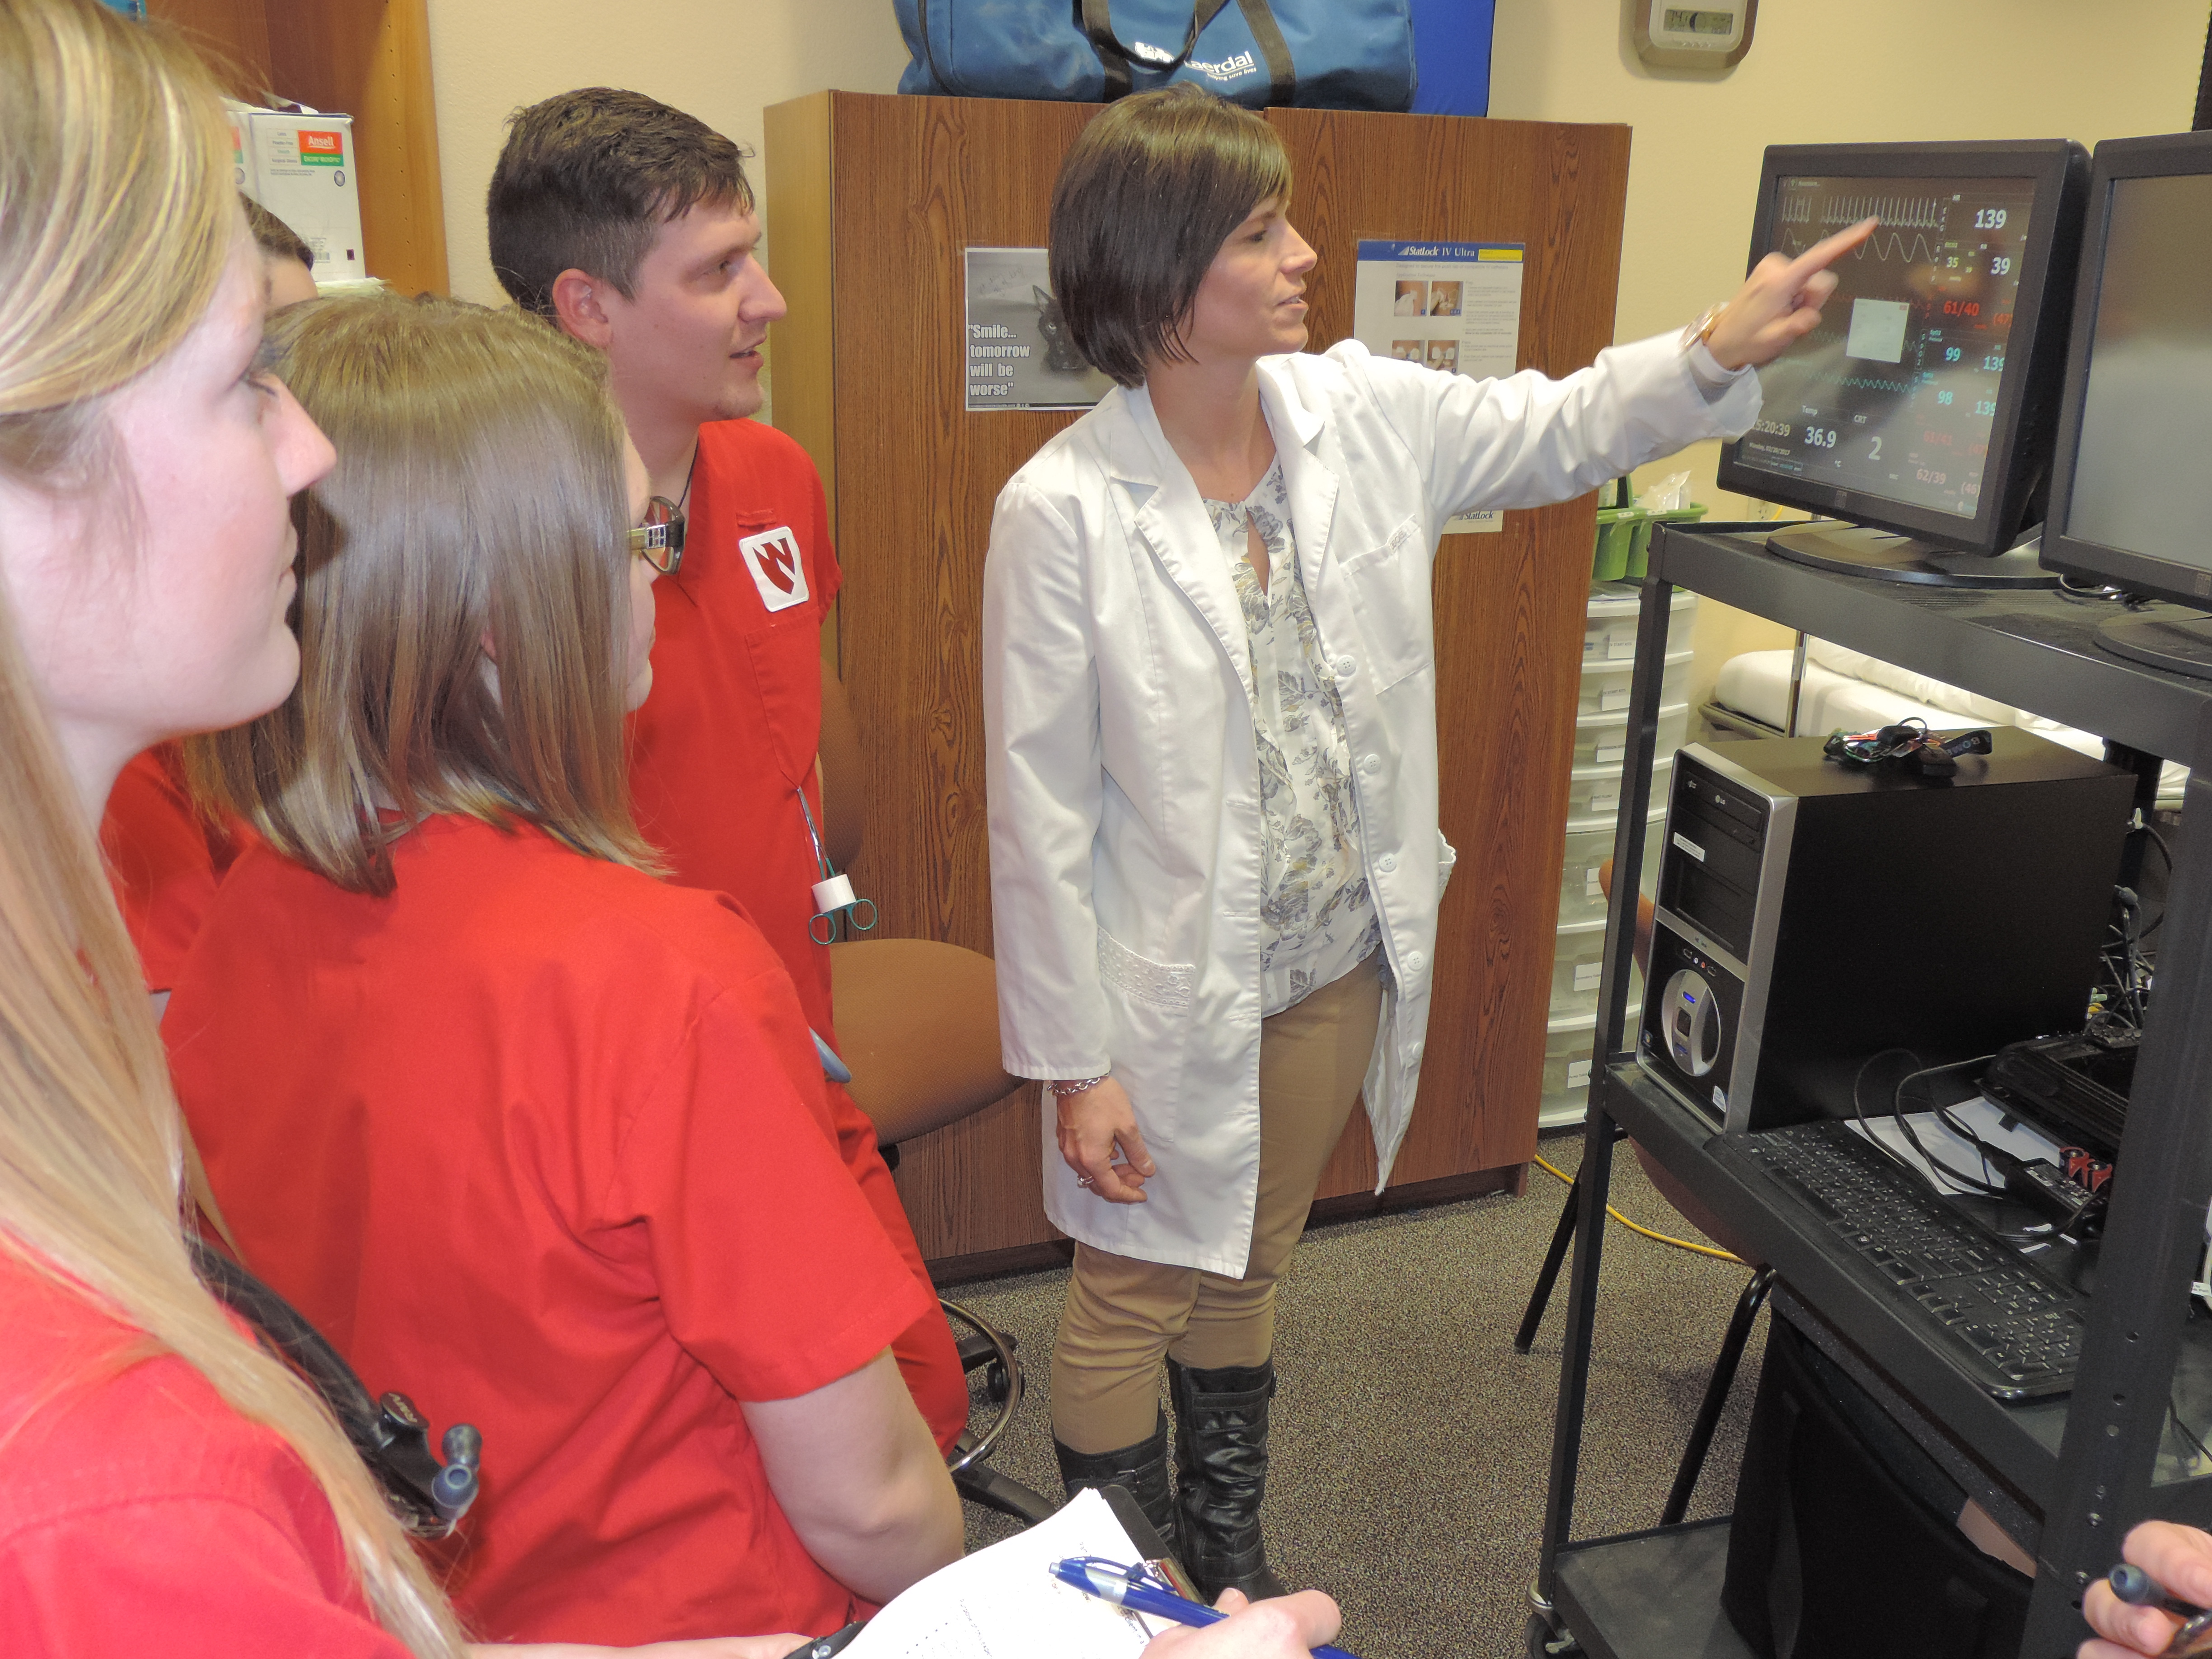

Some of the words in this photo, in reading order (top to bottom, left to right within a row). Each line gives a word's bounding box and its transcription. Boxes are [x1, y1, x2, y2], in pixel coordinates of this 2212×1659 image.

[1184, 51, 1253, 74] aerdal
[1207, 71, 1228, 81] helping
[1243, 66, 1257, 75] lives
[308, 136, 334, 146] Ansell
[1974, 209, 2007, 229] 139
[1409, 246, 1439, 256] StatLock
[1442, 248, 1452, 256] IV
[1454, 248, 1475, 257] Ultra
[1946, 256, 1959, 268] 35
[1991, 257, 2011, 275] 39
[1944, 300, 1980, 317] 61/40
[970, 344, 1031, 358] tomorrow
[1945, 347, 1962, 362] 99
[970, 363, 993, 377] will
[998, 363, 1014, 377] be
[970, 382, 1014, 396] worse"
[1937, 390, 1954, 405] 98
[1802, 405, 1818, 417] Temp
[1854, 414, 1867, 424] CRT
[1752, 418, 1790, 437] 5:20:39
[1804, 426, 1837, 448] 36.9
[1868, 436, 1883, 461] 2
[1916, 469, 1946, 485] 62/39
